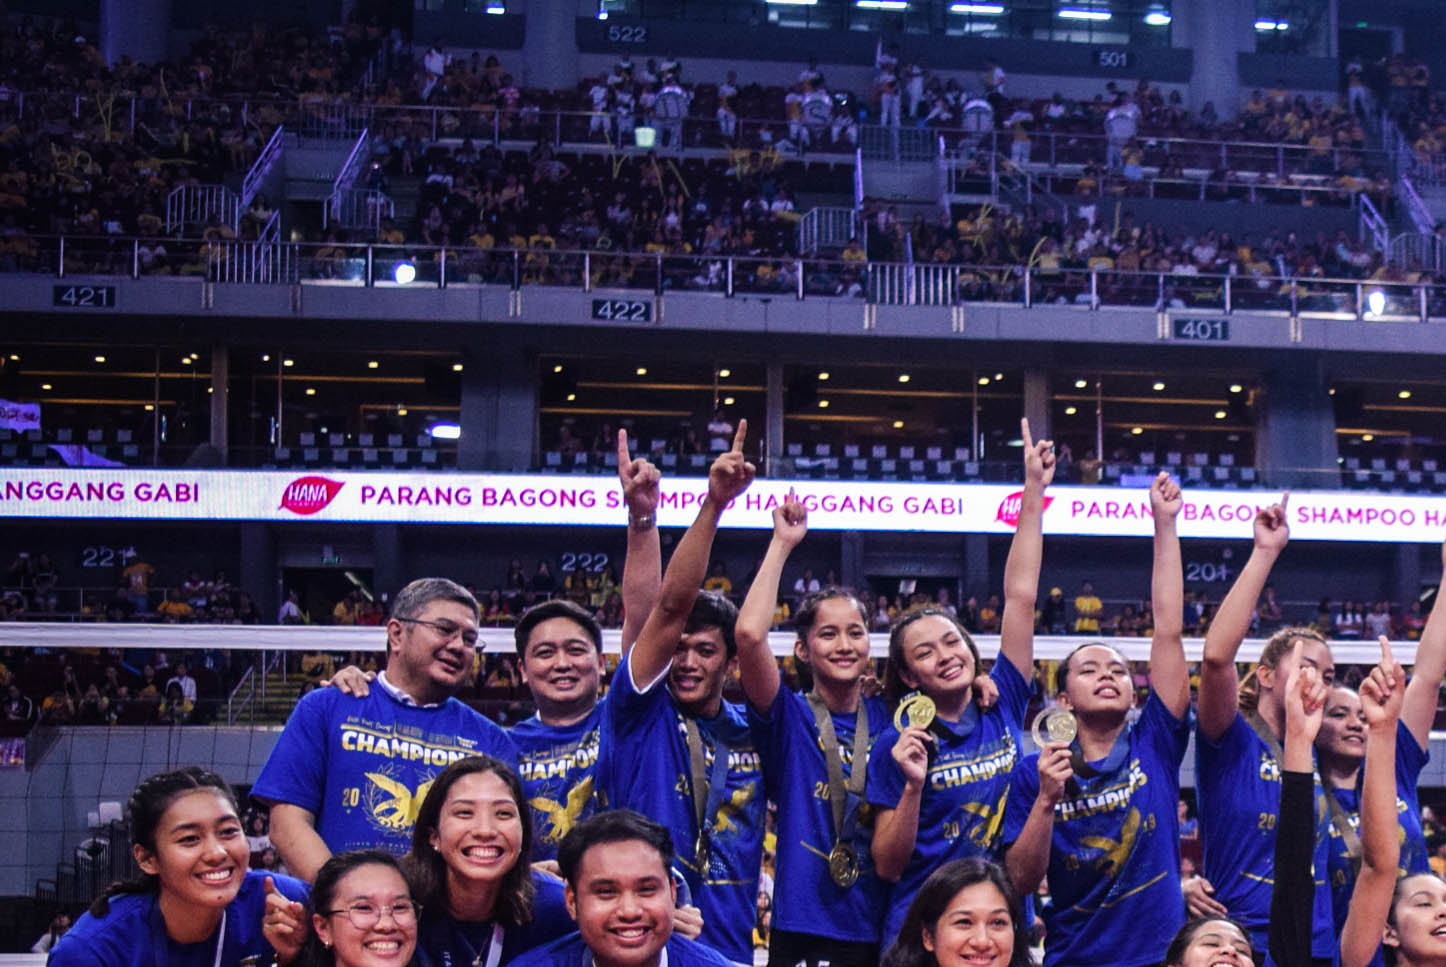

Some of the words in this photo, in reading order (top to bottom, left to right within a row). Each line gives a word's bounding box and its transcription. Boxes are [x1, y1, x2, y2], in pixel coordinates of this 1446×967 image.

[608, 25, 647, 42] 522
[1100, 51, 1127, 67] 501
[61, 286, 108, 306] 421
[597, 300, 646, 321] 422
[1181, 321, 1229, 340] 401
[0, 481, 125, 502] NGGANG
[134, 482, 199, 503] GABI
[288, 484, 328, 502] HANA
[361, 485, 472, 506] PARANG
[482, 488, 596, 508] BAGONG
[904, 496, 963, 516] GABI
[1071, 500, 1155, 521] PARAN
[1297, 506, 1416, 526] SHAMPOO
[561, 552, 609, 571] 222
[341, 730, 474, 767] CHAMPION
[1258, 812, 1276, 830] 20
